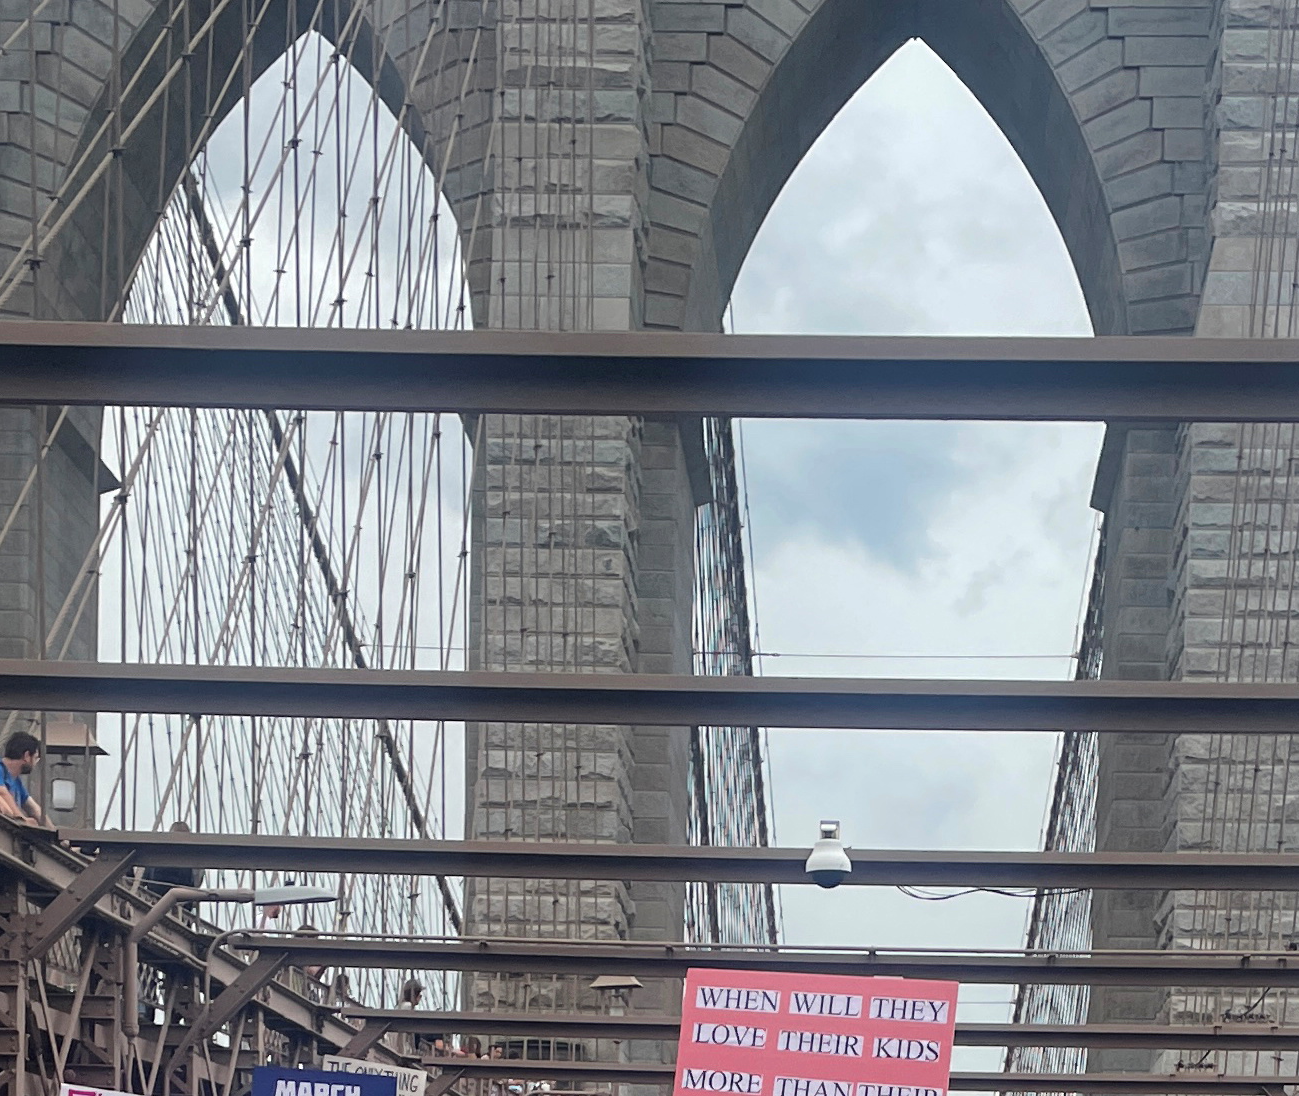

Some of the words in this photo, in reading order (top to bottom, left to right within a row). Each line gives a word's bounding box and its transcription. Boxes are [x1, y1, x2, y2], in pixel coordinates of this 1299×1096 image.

[700, 987, 779, 1012] WHEN
[794, 993, 860, 1016] WILL
[873, 997, 947, 1022] THEY
[696, 1024, 765, 1048] LOVE
[782, 1031, 860, 1056] THEIR
[876, 1038, 939, 1061] KIDS
[685, 1070, 761, 1094] MORE
